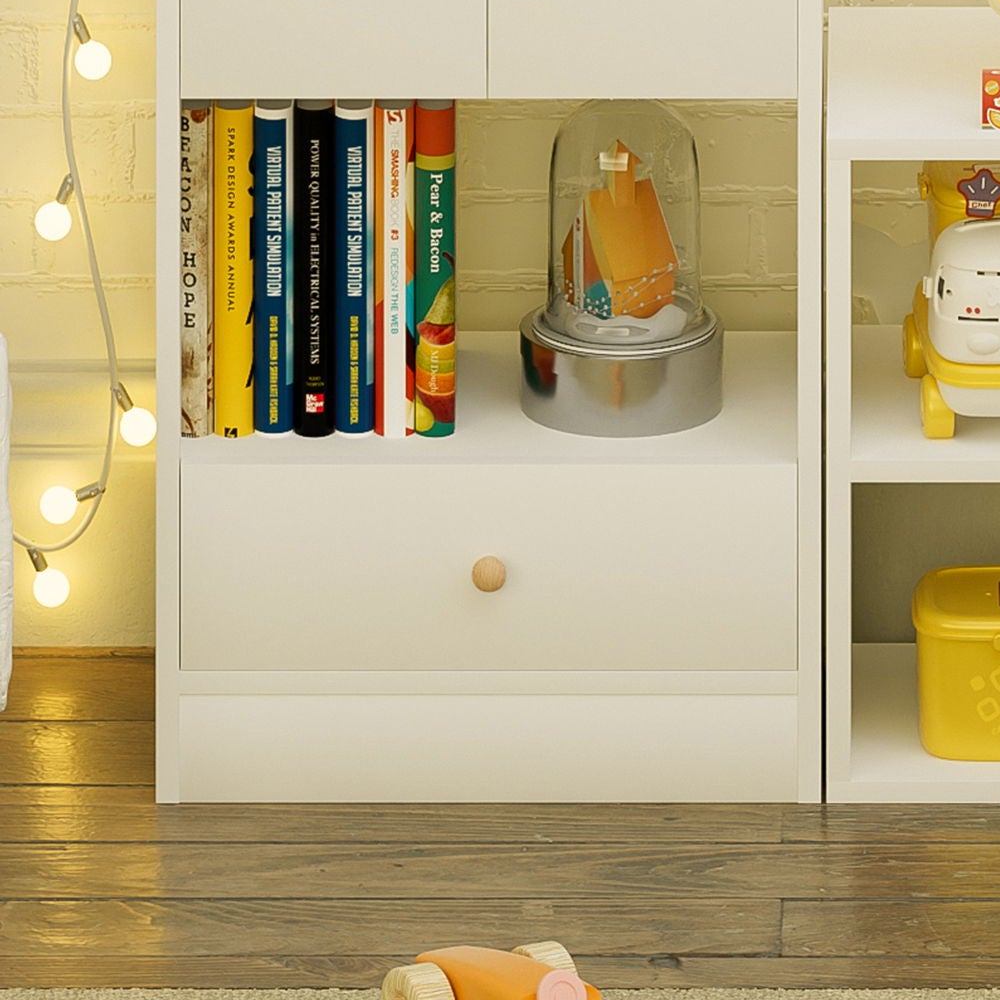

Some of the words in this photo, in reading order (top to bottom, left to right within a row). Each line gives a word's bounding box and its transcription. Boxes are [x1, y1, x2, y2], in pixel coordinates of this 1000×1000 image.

[227, 128, 236, 161] SPARK
[309, 139, 320, 178] POWER
[227, 165, 236, 209] DESIGN
[266, 146, 282, 189] VIRTUAL
[347, 146, 362, 189] VIRTUAL
[390, 149, 400, 198] SMASHING
[266, 191, 282, 233] PATIENT
[308, 181, 320, 231] QUALITY
[347, 191, 362, 233] PATIENT
[430, 173, 443, 208] Pear
[227, 213, 236, 260] AWARDS
[310, 233, 320, 242] in
[430, 211, 443, 224] &
[266, 235, 282, 297] SIMULATION
[347, 235, 362, 297] SIMULATION
[430, 228, 443, 273] Bacon
[183, 252, 196, 328] HOPE
[227, 265, 236, 312] ANNUAL
[310, 244, 320, 313] ELECTRICAL
[390, 293, 399, 311] THE
[310, 315, 320, 365] SYSTEMS
[390, 314, 399, 335] WEB
[428, 364, 440, 394] Dough
